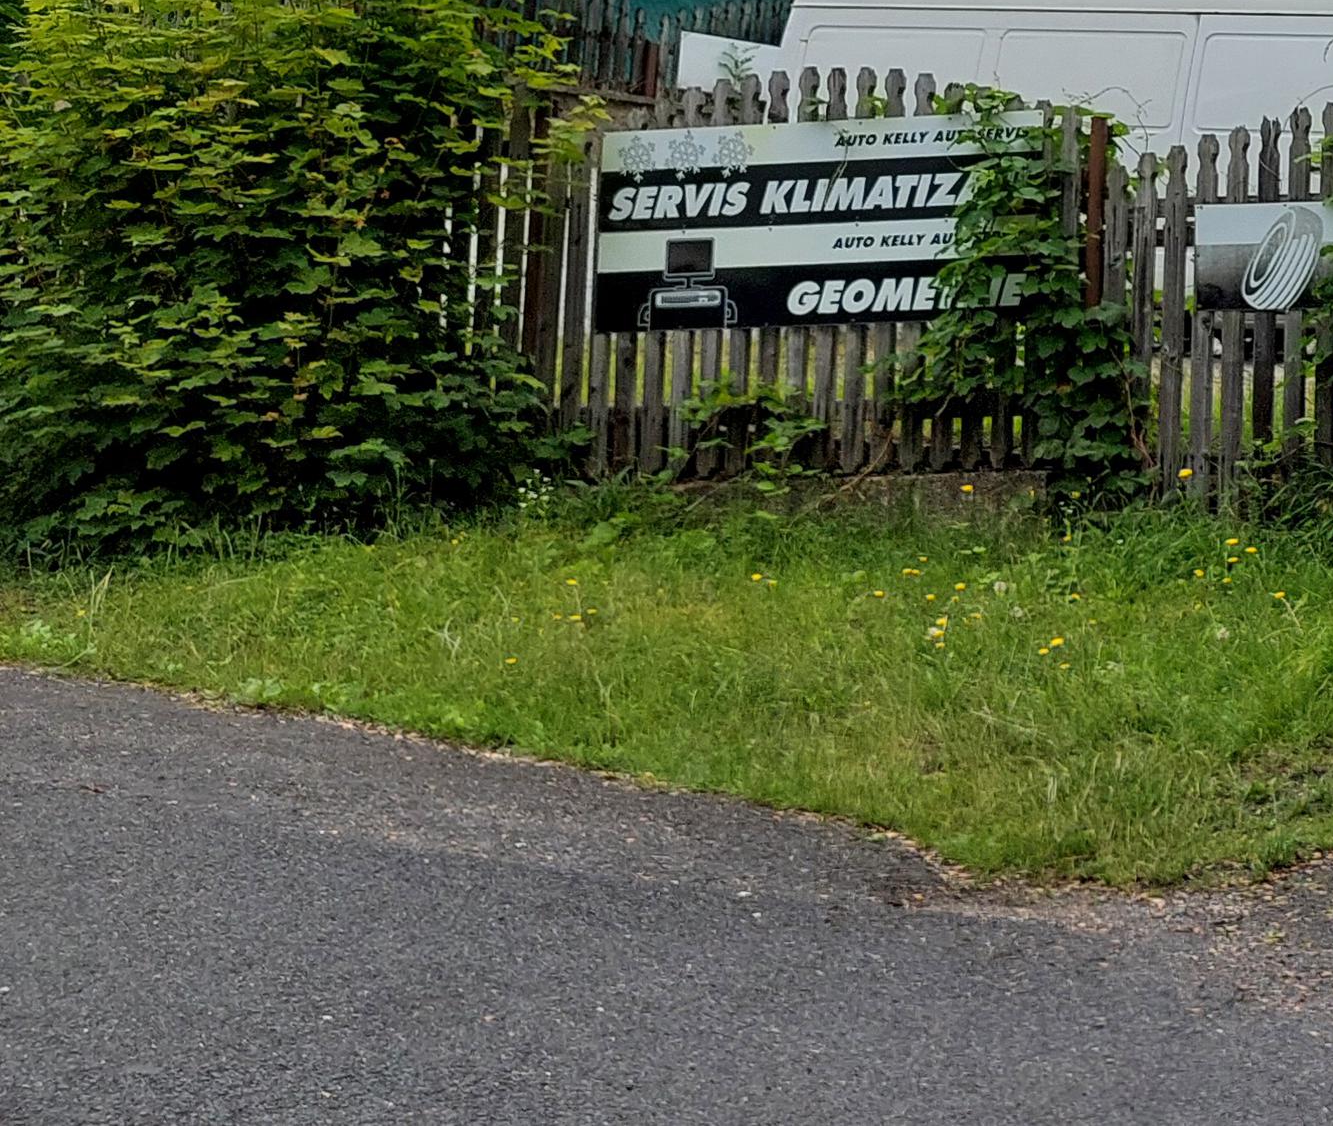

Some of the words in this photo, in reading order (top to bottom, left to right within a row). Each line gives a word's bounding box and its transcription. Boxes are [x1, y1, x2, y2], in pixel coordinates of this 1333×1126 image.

[834, 133, 876, 148] AUTO
[882, 131, 930, 146] KELLY
[608, 181, 751, 221] SERVIS
[832, 236, 875, 250] AUTO
[880, 234, 926, 248] KELLY
[786, 274, 1028, 316] GEOMEIE
